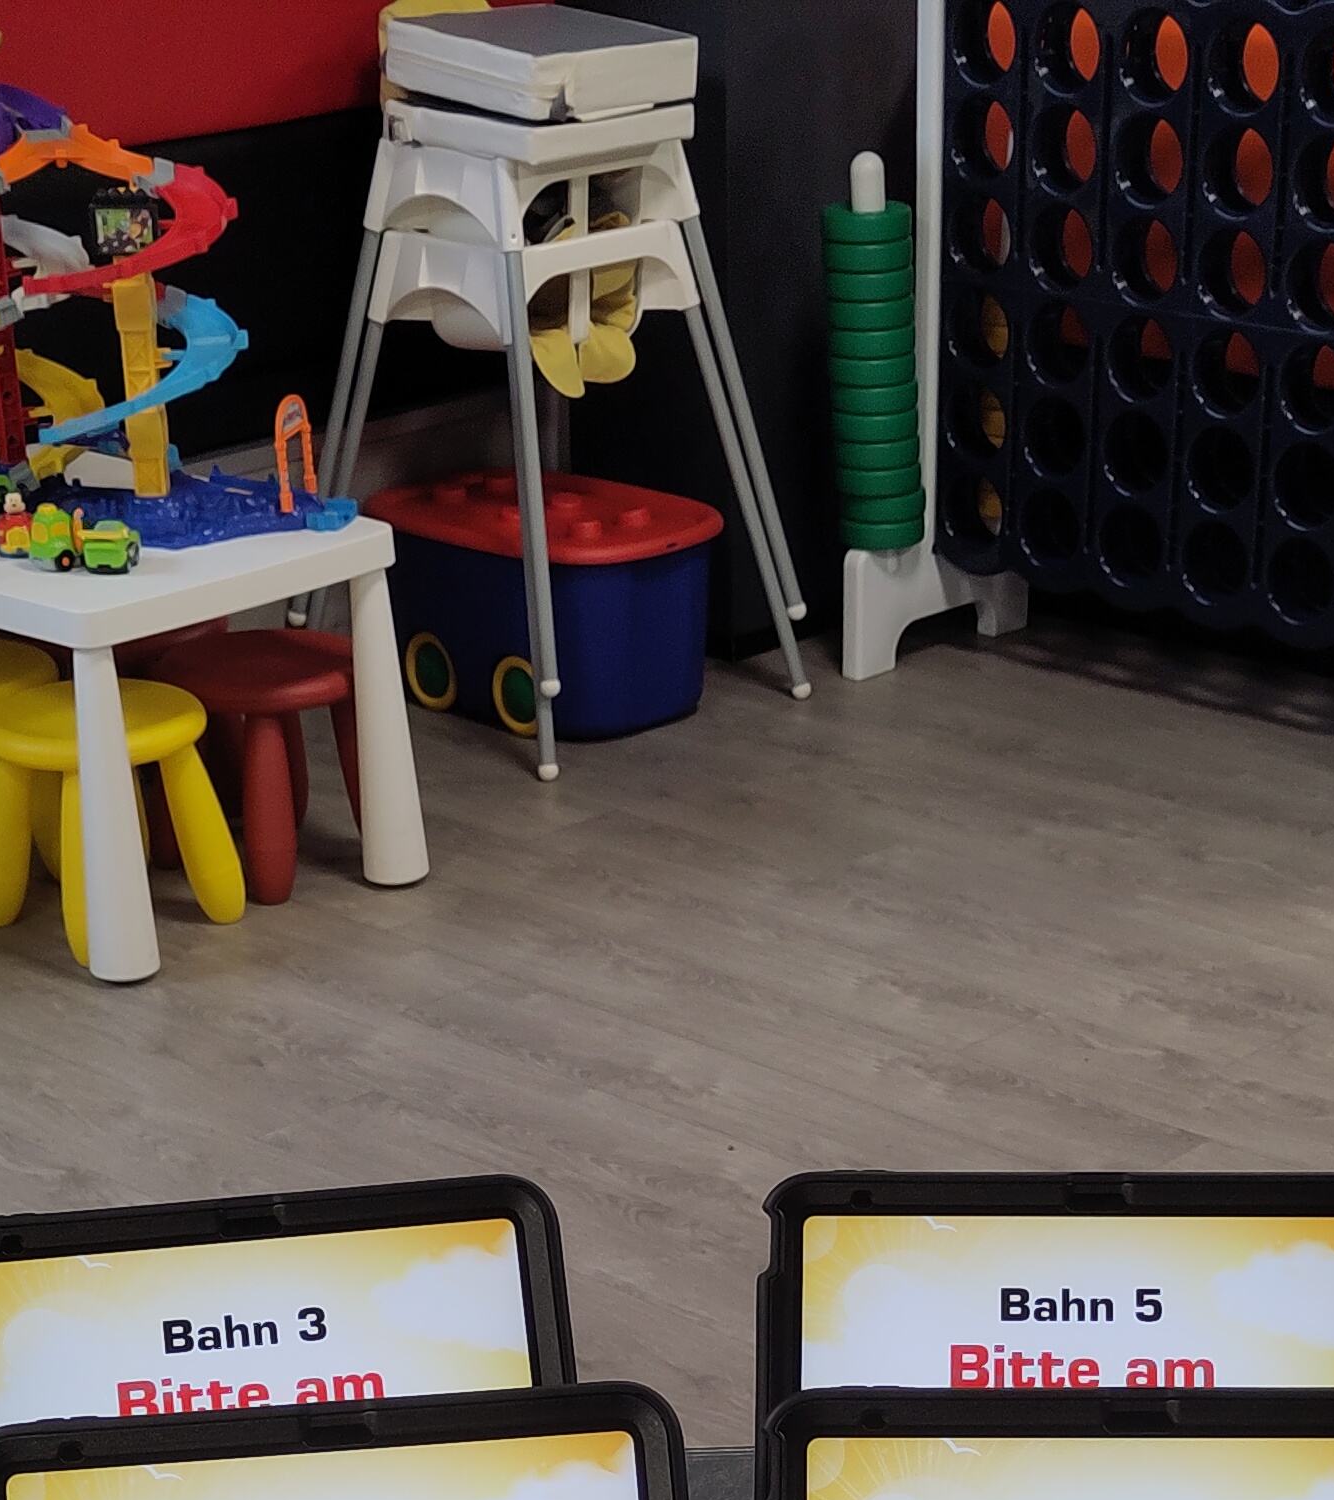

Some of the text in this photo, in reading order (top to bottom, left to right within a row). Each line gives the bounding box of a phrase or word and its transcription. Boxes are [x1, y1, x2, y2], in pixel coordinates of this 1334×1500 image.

[1000, 1287, 1164, 1322] Bahn 5
[164, 1306, 327, 1355] Bahn 3
[949, 1345, 1215, 1388] Bitte am
